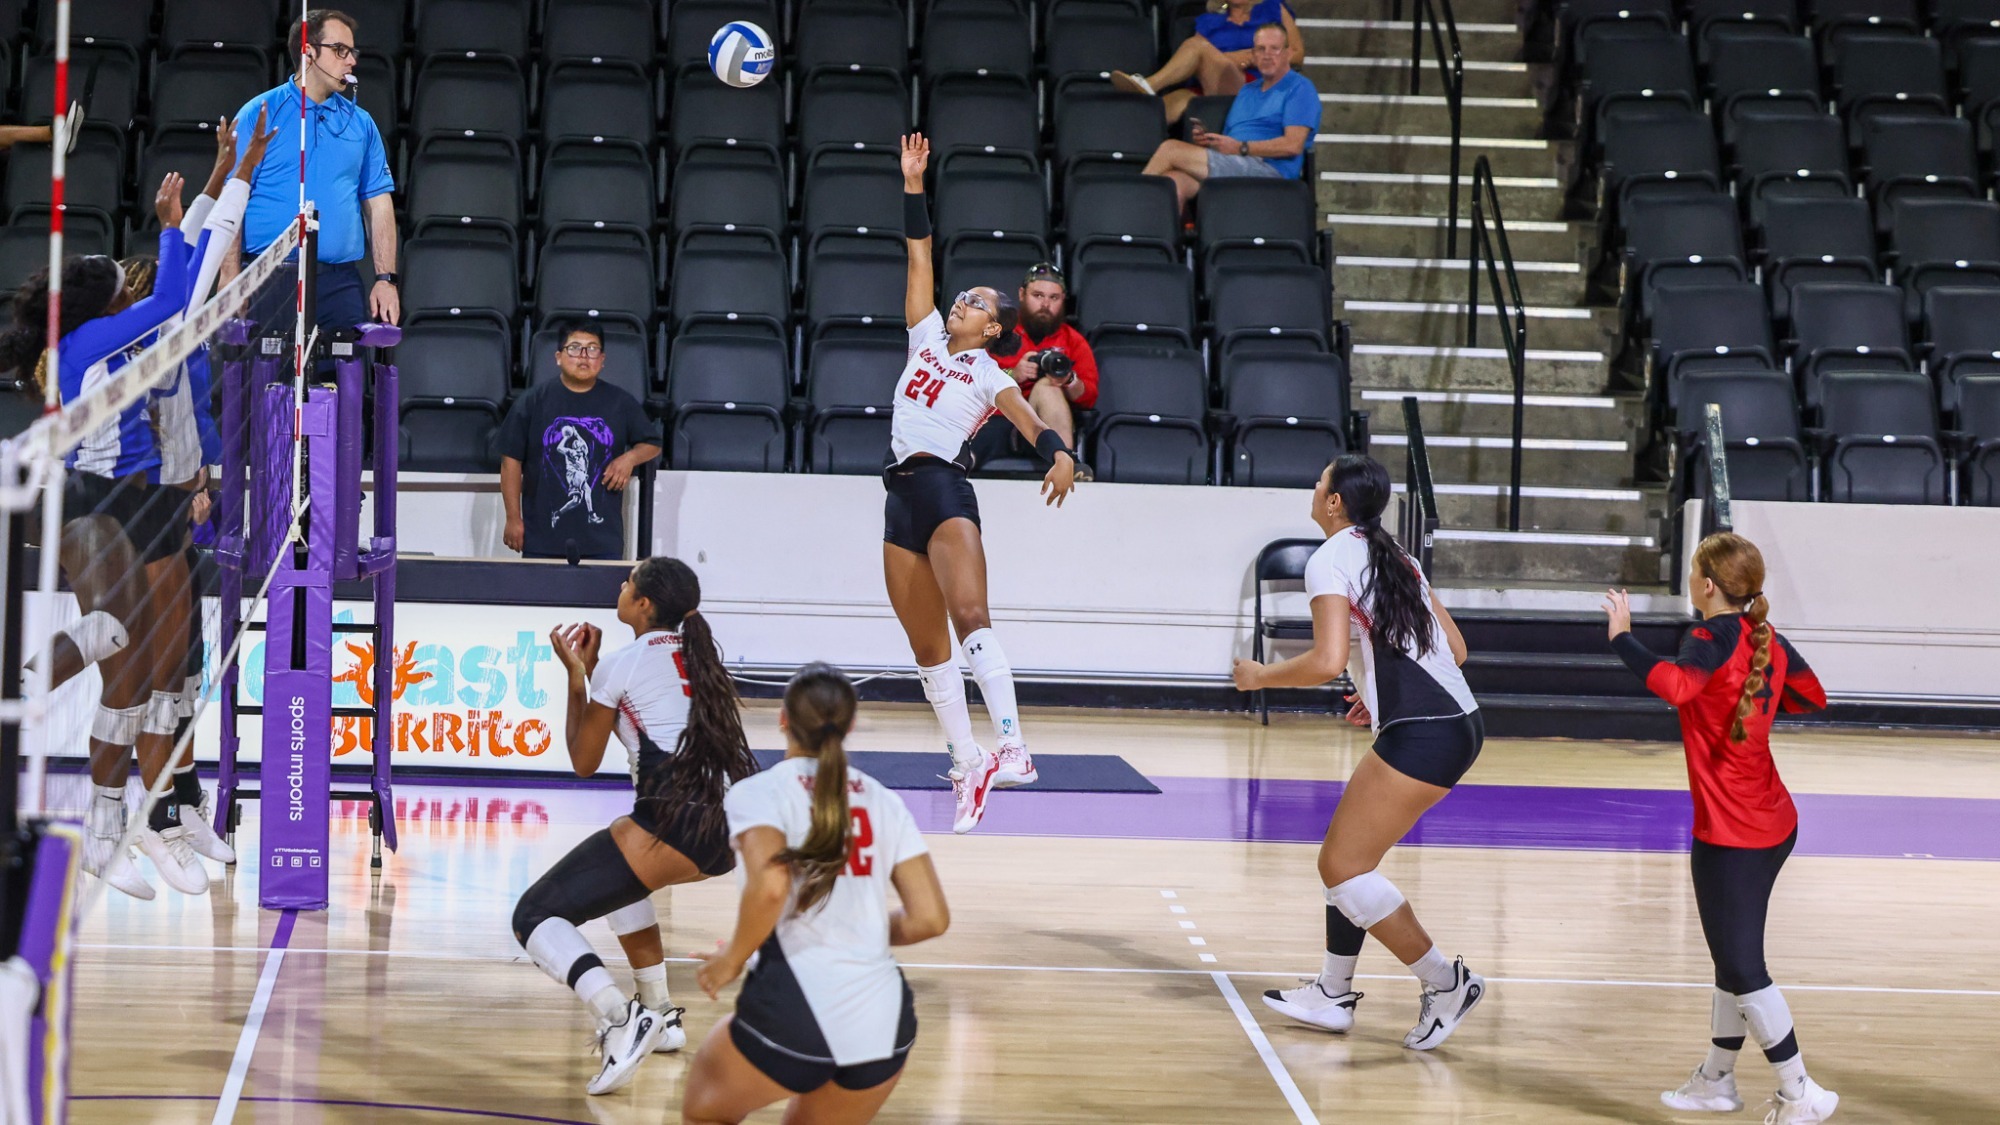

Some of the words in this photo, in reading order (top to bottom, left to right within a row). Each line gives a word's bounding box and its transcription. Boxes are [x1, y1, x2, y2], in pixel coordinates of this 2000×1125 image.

[904, 368, 946, 409] 24
[946, 369, 974, 385] PEAY
[288, 696, 306, 751] sports
[287, 754, 305, 821] imports
